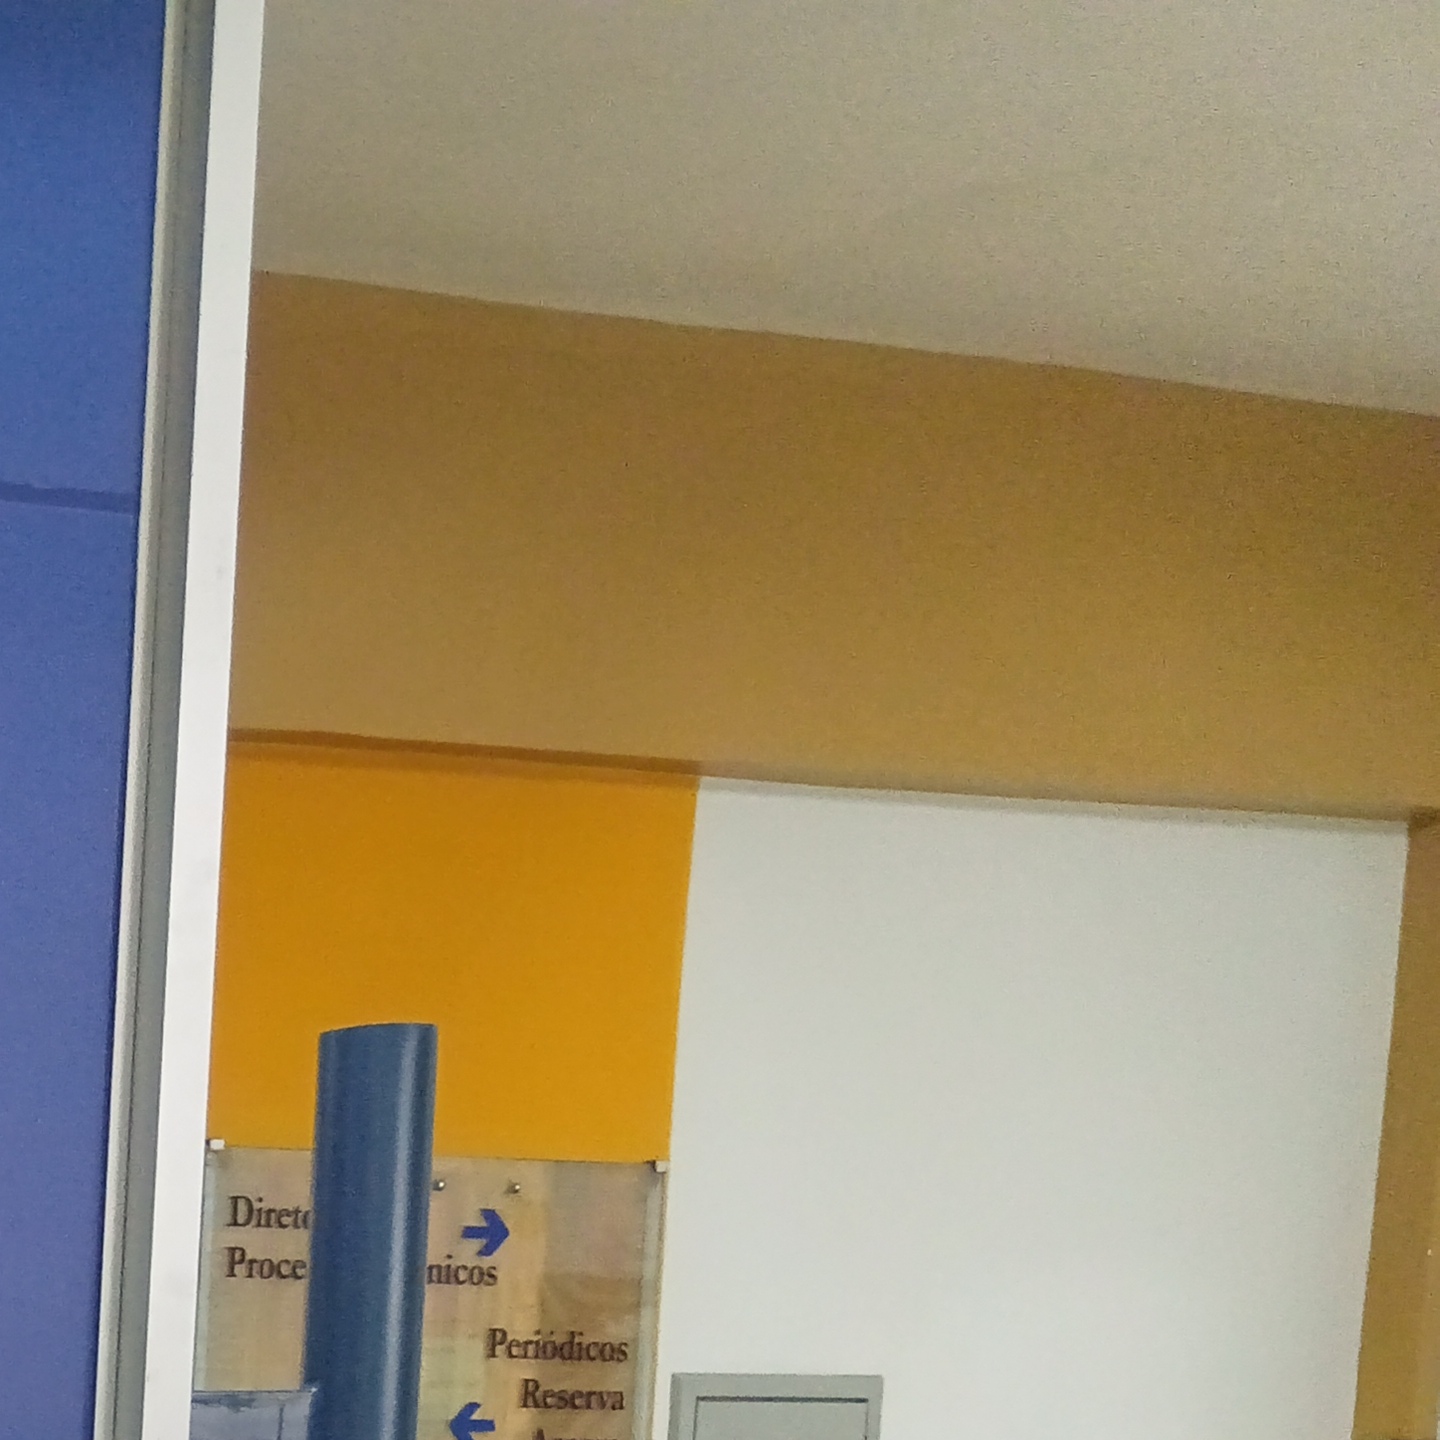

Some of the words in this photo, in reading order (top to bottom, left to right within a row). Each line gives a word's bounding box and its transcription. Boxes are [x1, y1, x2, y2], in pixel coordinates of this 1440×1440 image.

[224, 1246, 307, 1280] Proce
[427, 1254, 498, 1287] nicos
[486, 1327, 629, 1363] Periódicos
[520, 1378, 625, 1411] Reserva
